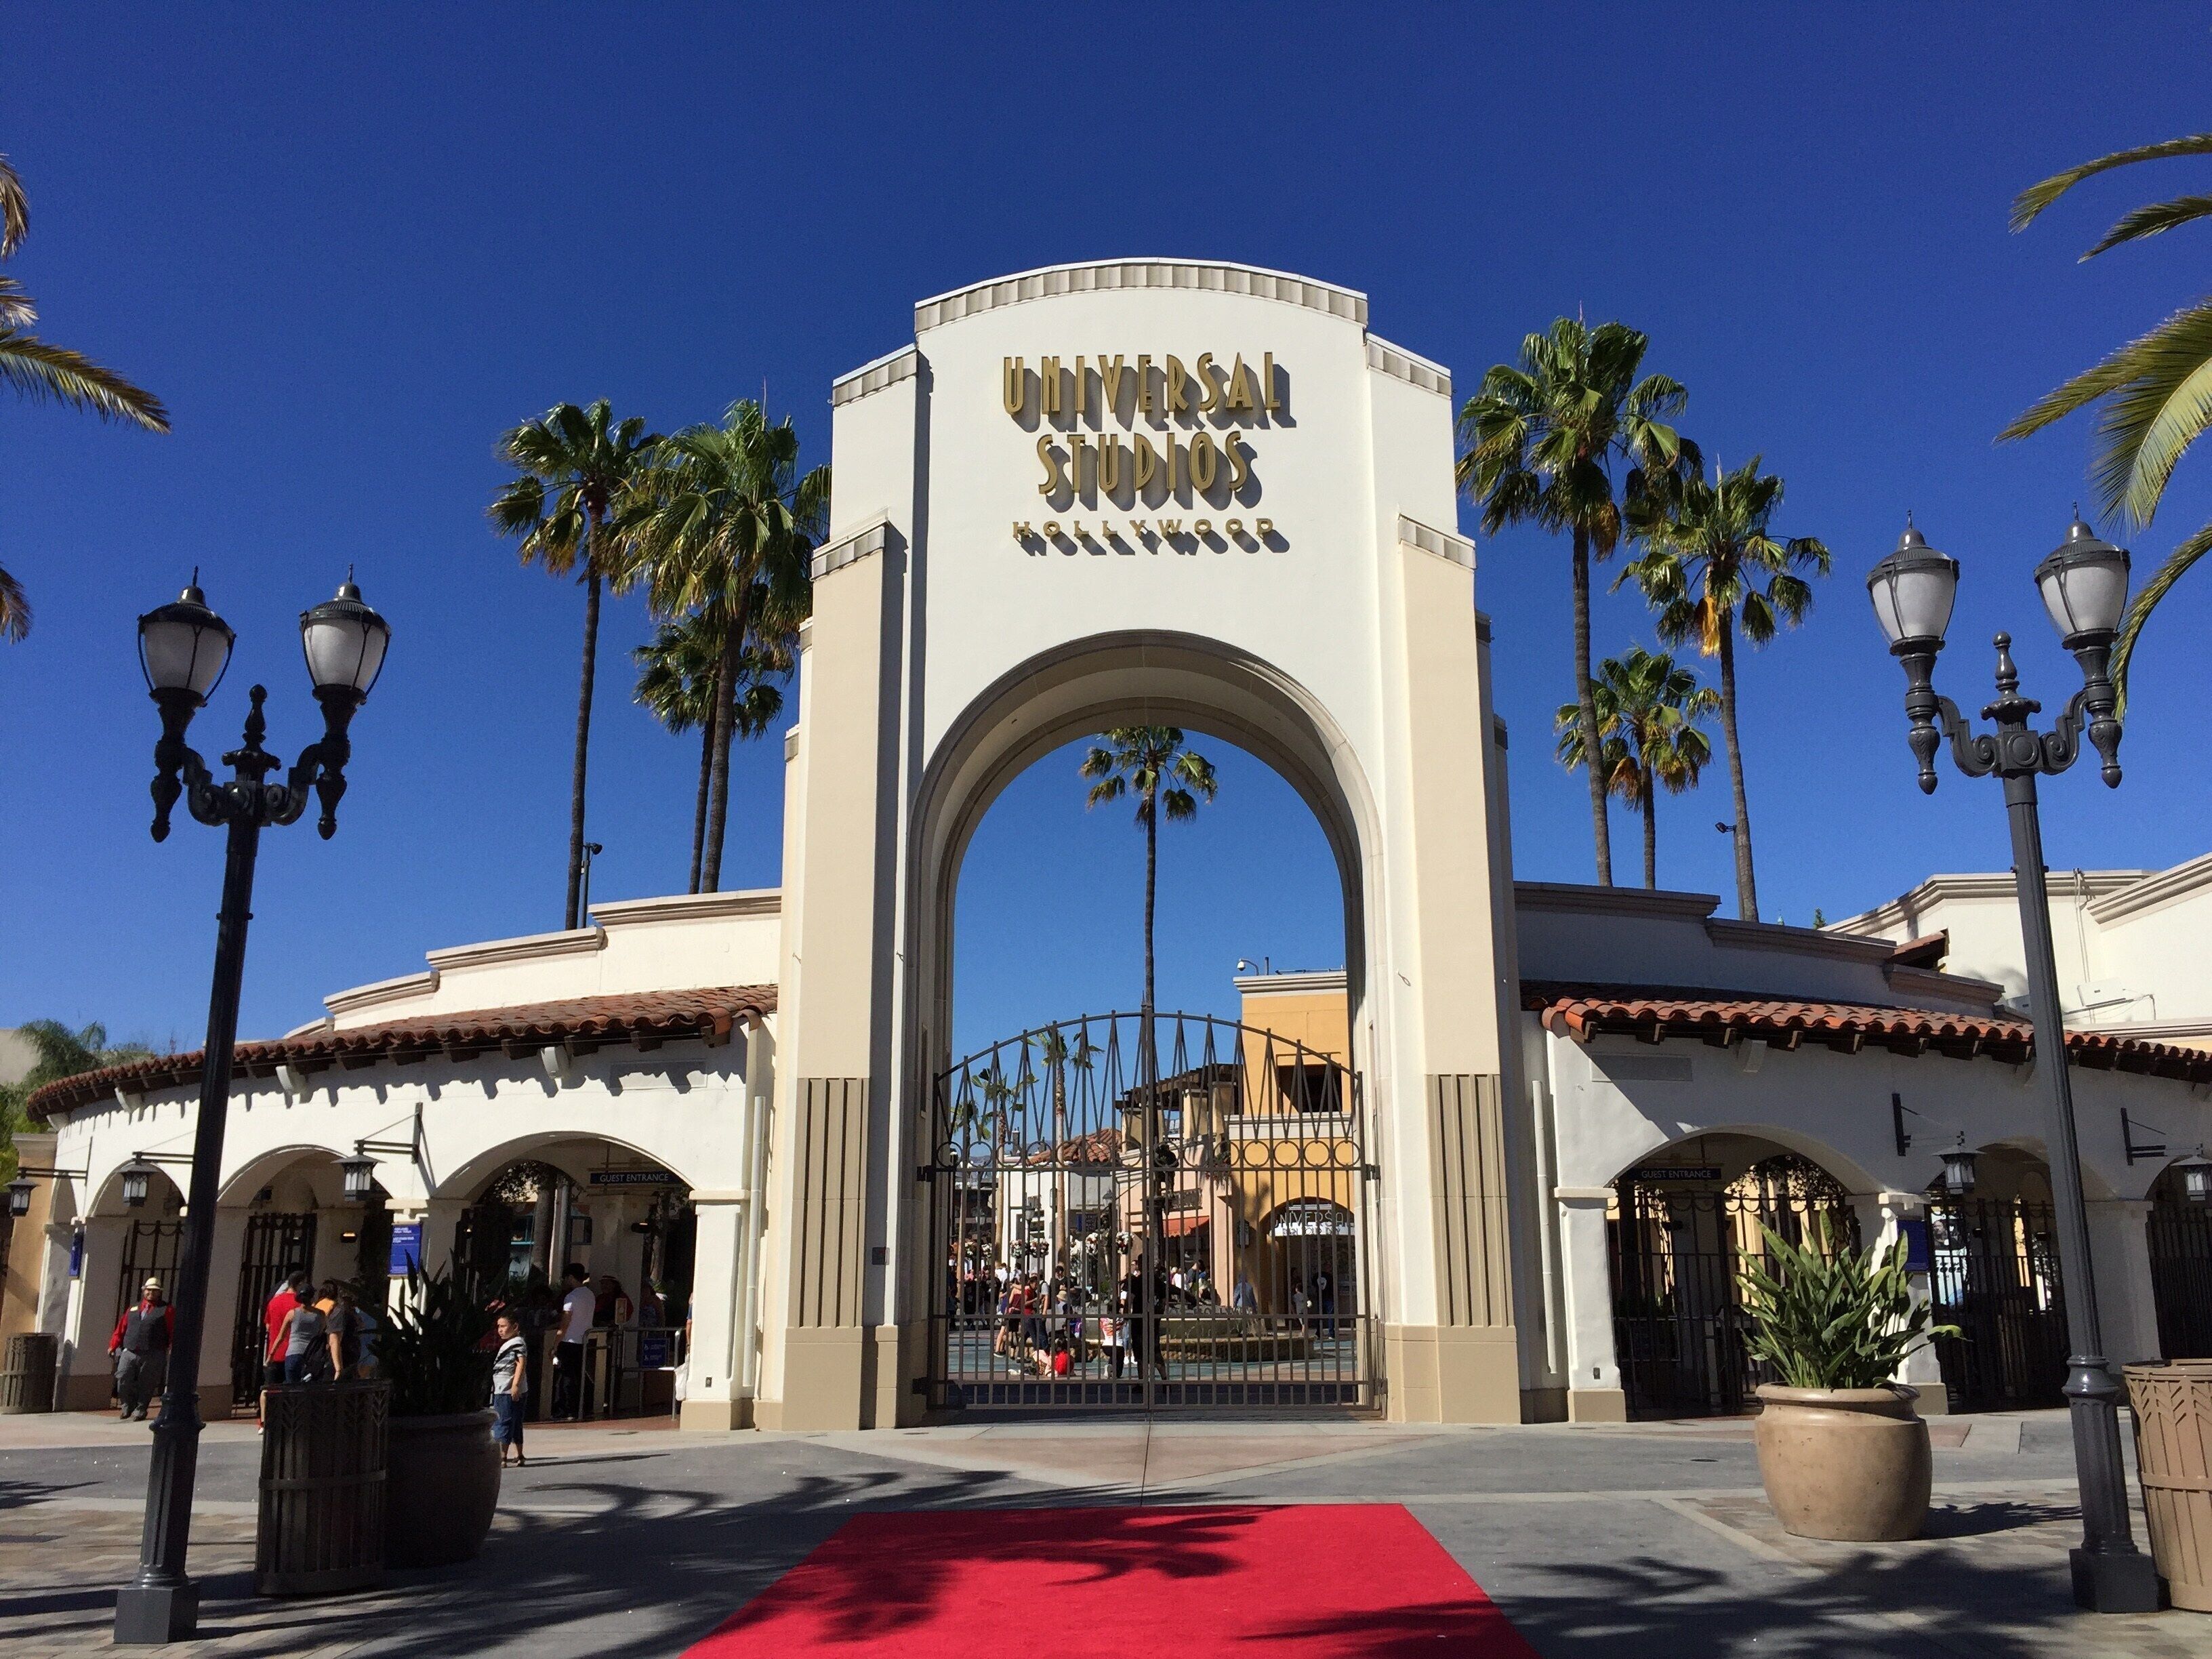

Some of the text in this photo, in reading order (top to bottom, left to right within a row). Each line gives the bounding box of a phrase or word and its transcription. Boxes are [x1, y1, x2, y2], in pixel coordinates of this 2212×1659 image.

[1003, 351, 1281, 415] UNIVERSAL
[1036, 430, 1248, 494] STUDIOS
[1012, 518, 1273, 537] HOLLYWOOD
[599, 1173, 669, 1183] GUEST ENTRANCE
[1641, 1170, 1712, 1179] GUEST ENTRANCE
[1274, 1210, 1354, 1228] NIVERSA
